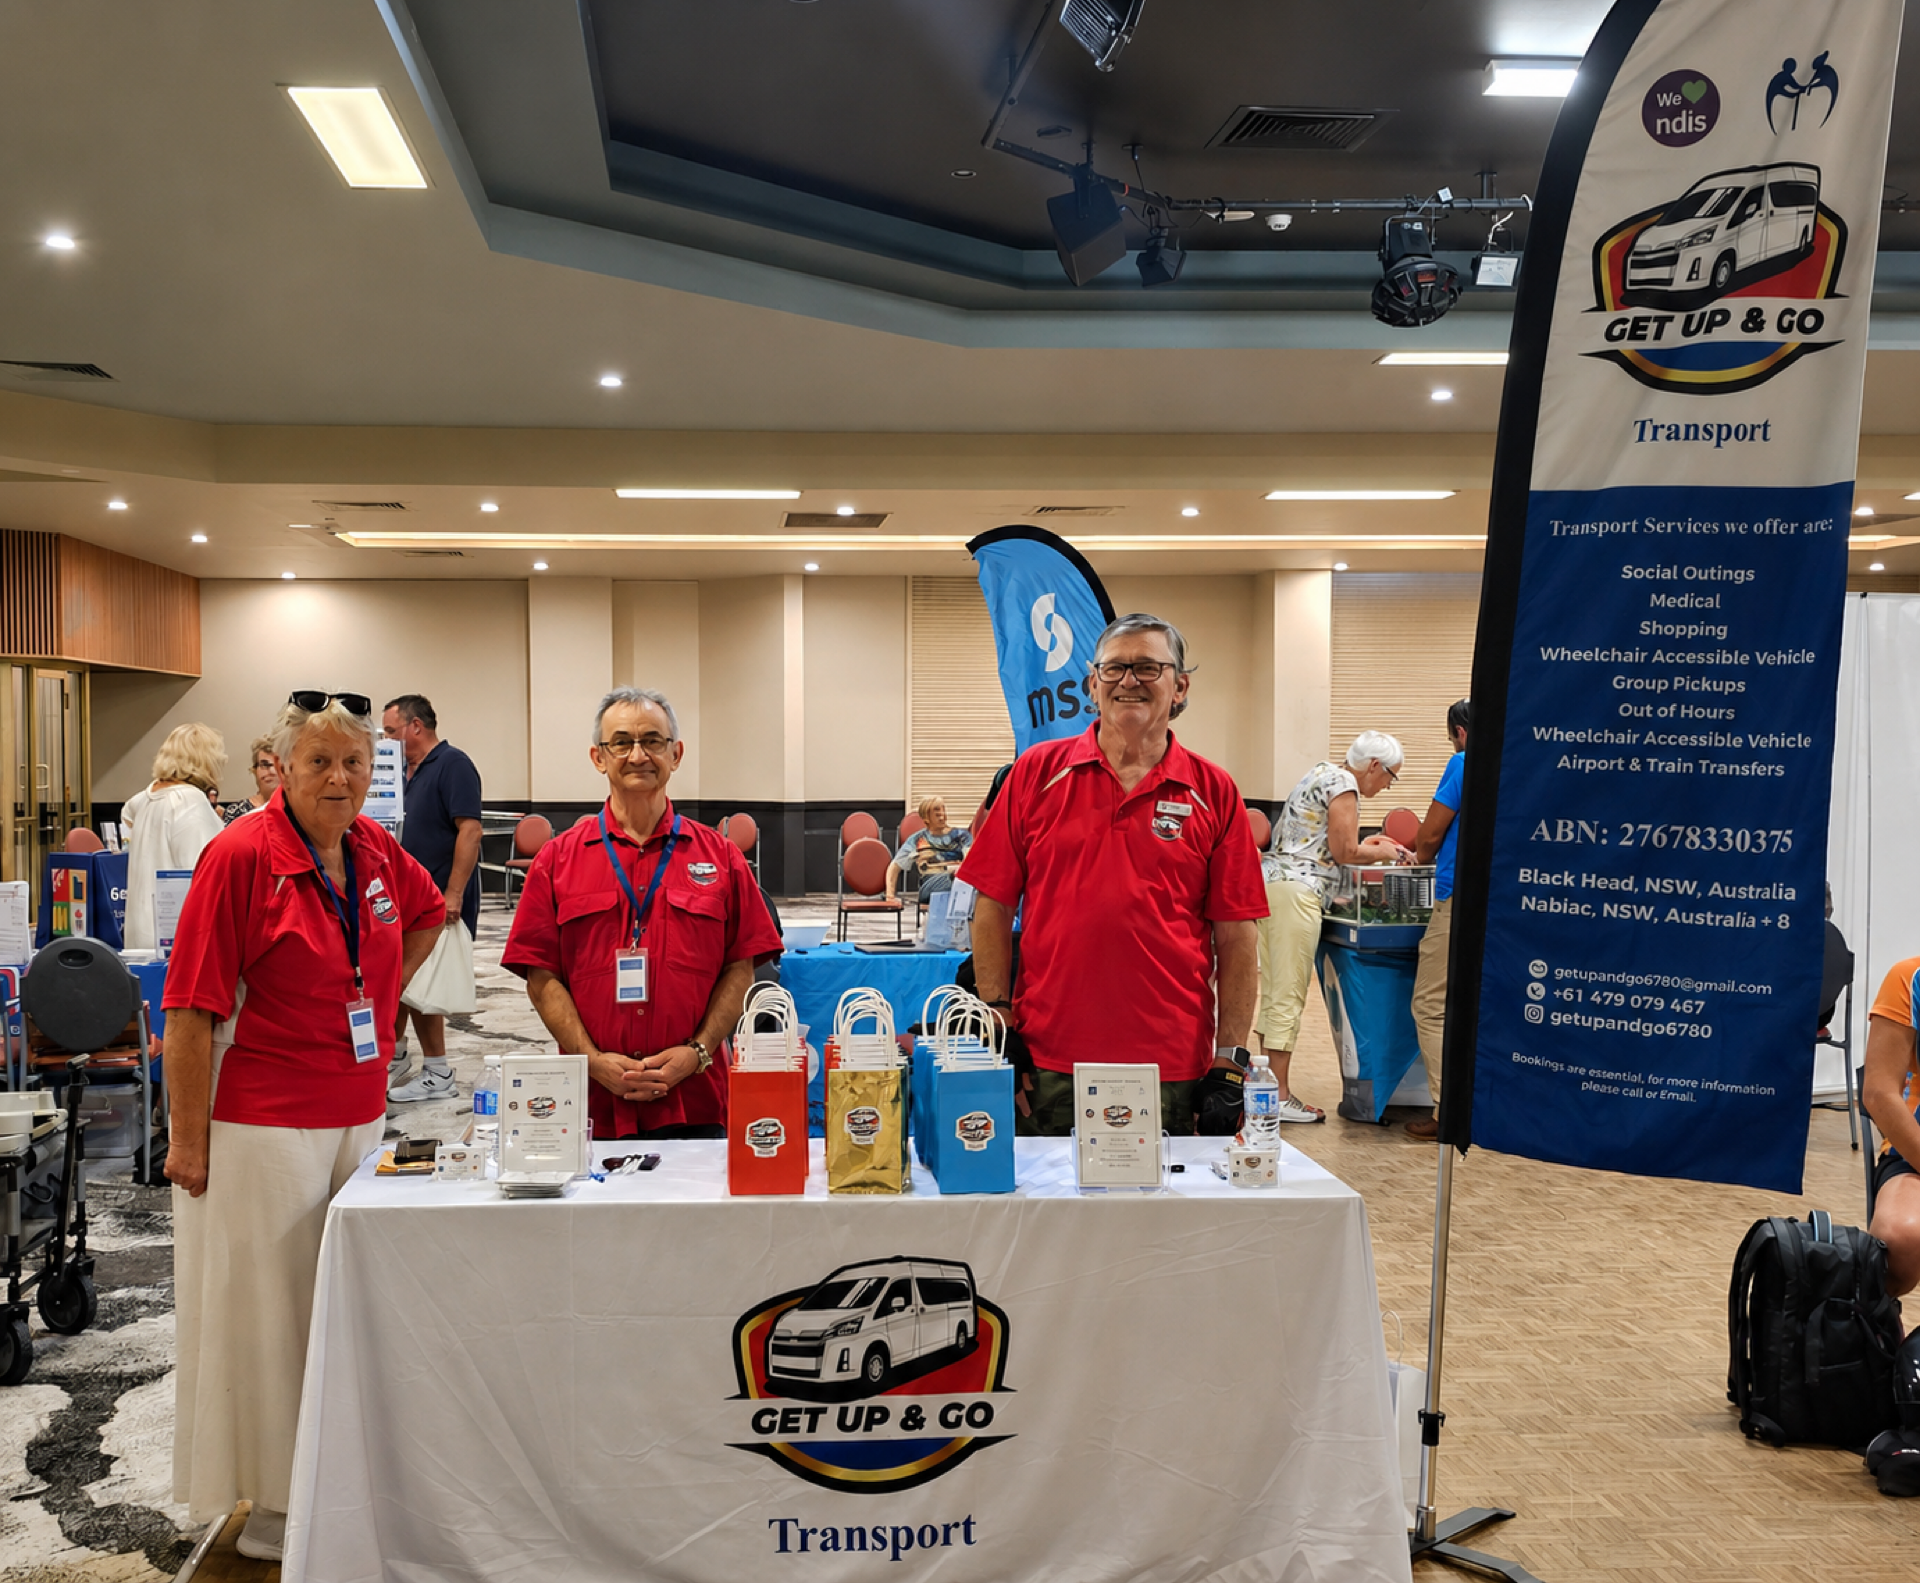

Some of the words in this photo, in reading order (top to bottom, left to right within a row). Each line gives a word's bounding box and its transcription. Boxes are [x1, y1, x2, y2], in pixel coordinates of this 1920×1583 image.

[1656, 92, 1682, 107] We
[1656, 110, 1707, 135] ndis
[1605, 314, 1674, 342] GET
[1681, 309, 1730, 338] UP
[1740, 306, 1766, 333] &
[1776, 308, 1824, 336] GO
[1634, 418, 1771, 448] Transport
[1550, 519, 1638, 537] Transport
[1644, 517, 1719, 535] Services
[1725, 522, 1748, 535] we
[1753, 518, 1798, 535] offer
[1804, 517, 1833, 535] are:
[1622, 565, 1678, 580] Social
[1683, 566, 1756, 584] Outings
[1650, 594, 1720, 609] Medical
[1639, 621, 1728, 640] Shopping
[1540, 647, 1648, 664] Wheelchair
[1652, 649, 1750, 666] Accessible
[1755, 649, 1815, 666] Vehicle
[1612, 676, 1669, 694] Group
[1674, 676, 1746, 695] Pickups
[1618, 702, 1653, 718] Out
[1656, 703, 1677, 718] of
[1680, 704, 1736, 720] Hours
[1532, 726, 1640, 745] Wheelchair
[1644, 730, 1742, 748] Accessible
[1748, 733, 1812, 749] Vehicle
[1557, 754, 1624, 774] Airport
[1629, 757, 1642, 772] &
[1646, 758, 1694, 774] Train
[1698, 760, 1784, 777] Transfers
[1530, 818, 1608, 846] ABN:
[1618, 822, 1794, 854] 27678330375
[1518, 868, 1575, 888] Black
[1581, 872, 1639, 894] Head,
[1645, 878, 1702, 899] NSW,
[1708, 882, 1796, 901] Australia
[1521, 896, 1597, 918] Nabiac,
[1602, 903, 1659, 924] NSW,
[1664, 908, 1756, 929] Australia
[1761, 916, 1772, 927] +
[1776, 914, 1790, 930] 8
[1554, 968, 1772, 995] getupandgo6780@gmail.com
[1553, 988, 1583, 1003] +61
[1590, 991, 1625, 1007] 479
[1630, 995, 1664, 1011] 079
[1670, 998, 1706, 1015] 467
[1550, 1012, 1713, 1038] getupandgo6780
[1512, 1052, 1565, 1072] Bookings
[1567, 1064, 1586, 1076] are
[1648, 1074, 1664, 1084] for
[1666, 1078, 1698, 1088] more
[1701, 1078, 1776, 1096] information
[1582, 1080, 1620, 1095] please
[1622, 1086, 1644, 1098] call
[1646, 1090, 1658, 1099] or
[750, 1406, 828, 1434] GET
[836, 1405, 890, 1432] UP
[899, 1404, 926, 1431] &
[938, 1400, 994, 1429] GO
[768, 1514, 977, 1562] Transport
